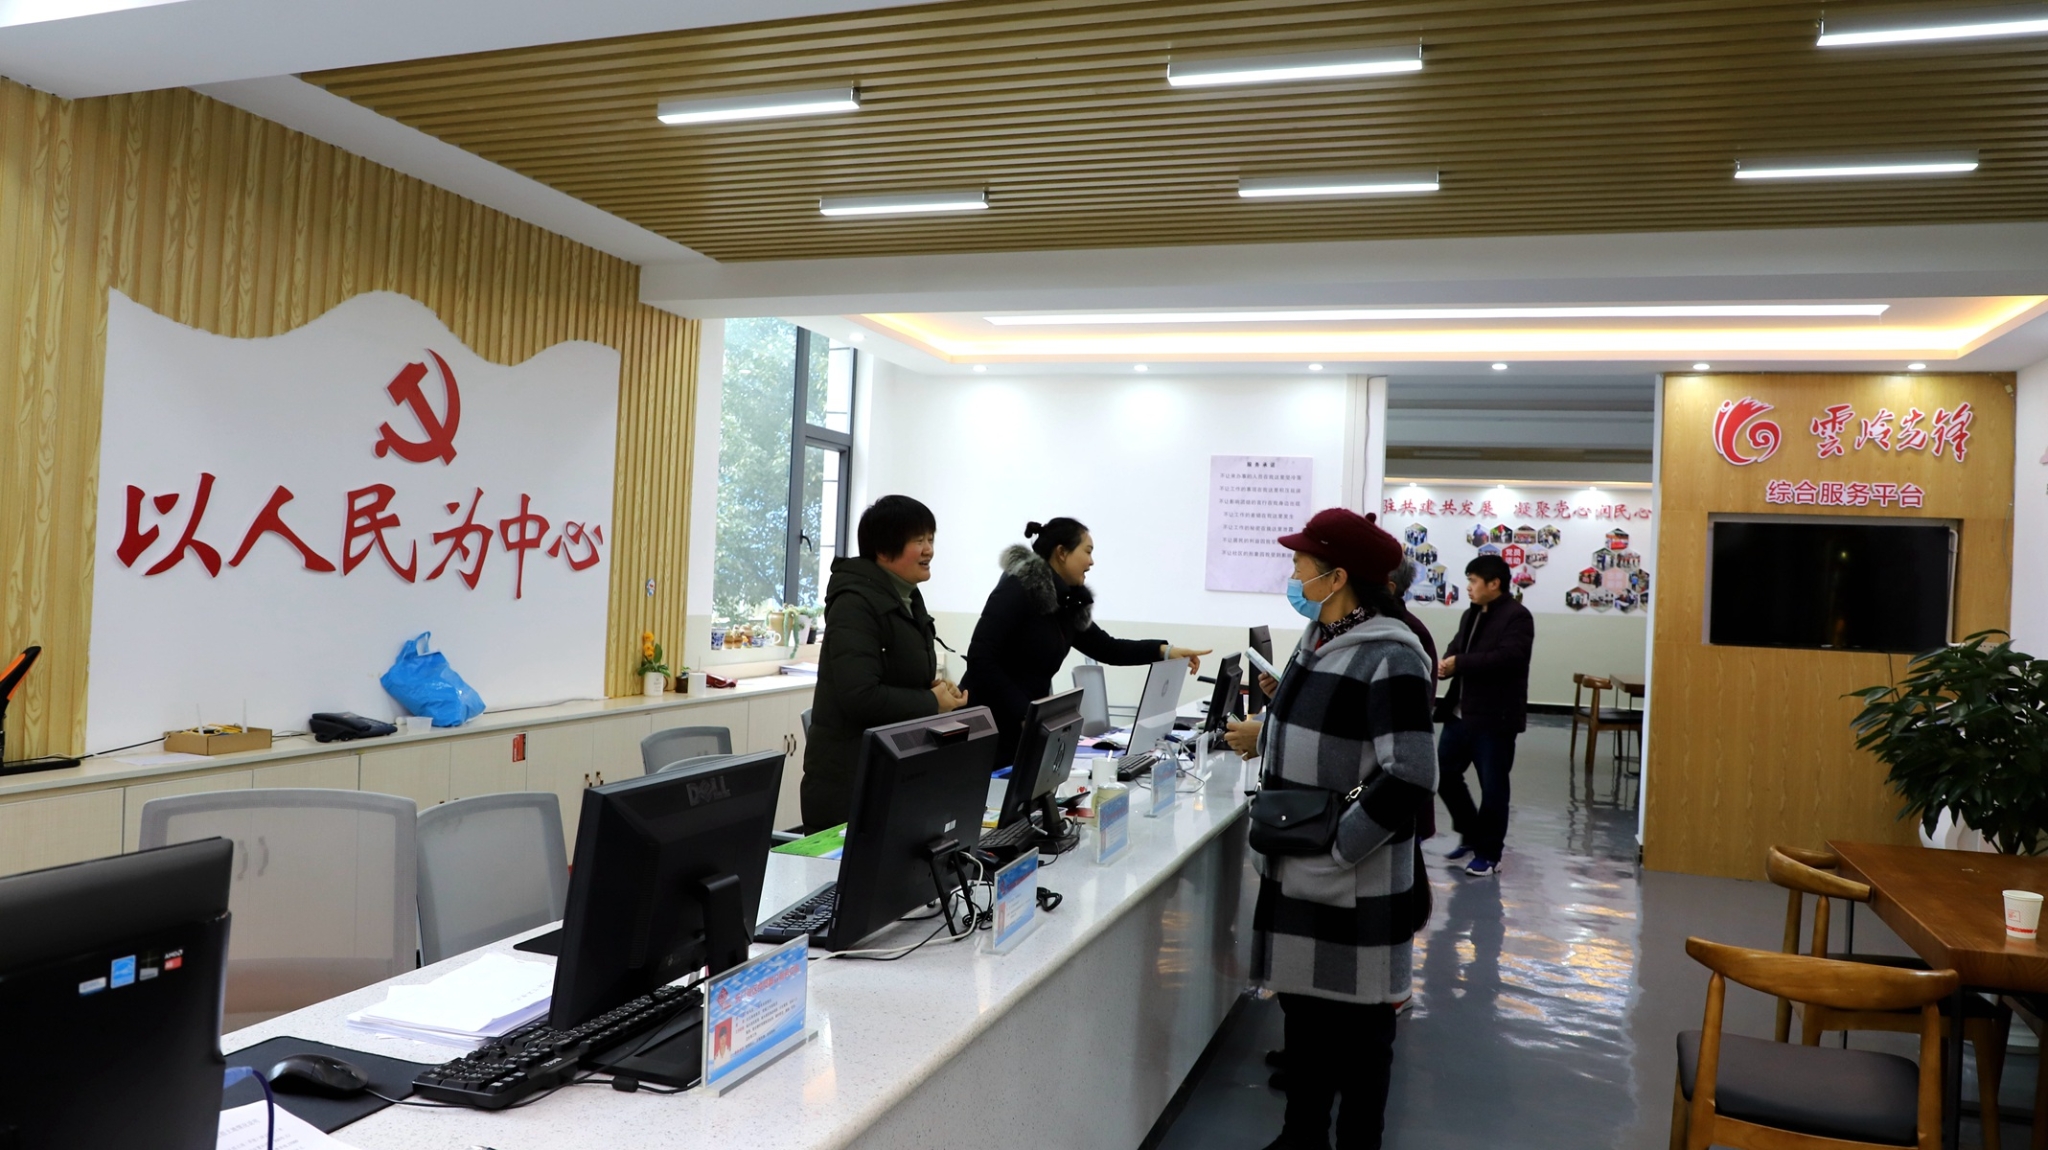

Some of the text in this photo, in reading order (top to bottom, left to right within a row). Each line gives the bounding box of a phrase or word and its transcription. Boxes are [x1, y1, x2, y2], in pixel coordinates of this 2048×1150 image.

[1767, 480, 1924, 507] 综合服务平台
[116, 472, 603, 600] 以人民为中心
[686, 775, 731, 807] DELL
